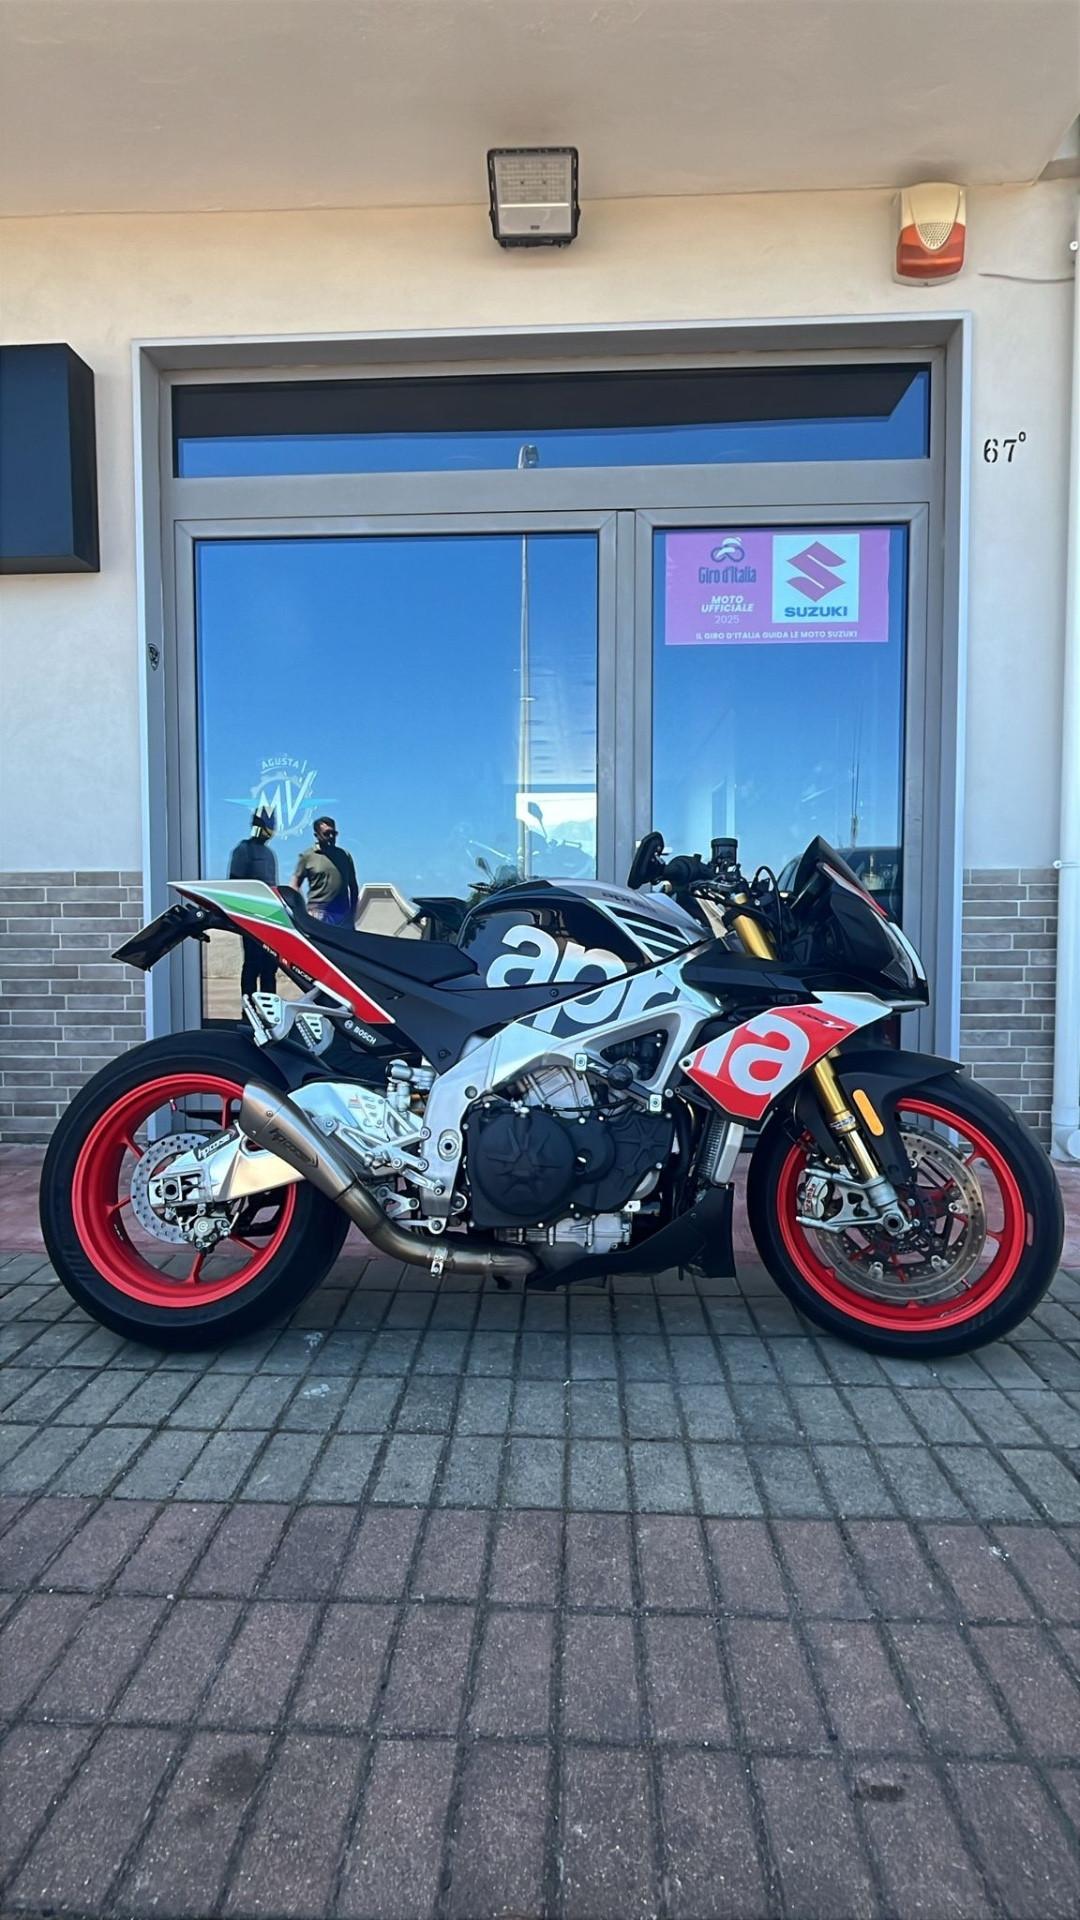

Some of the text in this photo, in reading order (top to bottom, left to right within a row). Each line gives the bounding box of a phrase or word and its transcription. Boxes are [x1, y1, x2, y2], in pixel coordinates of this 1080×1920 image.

[699, 566, 756, 584] Giro d'Italia
[711, 595, 744, 604] MOTO
[701, 603, 754, 613] UFFICIALE
[784, 606, 848, 617] SUZUKI
[714, 614, 740, 624] 2025
[704, 632, 725, 640] GIRO
[726, 631, 760, 640] D'ITALIA
[762, 631, 789, 639] GUIDA
[790, 631, 798, 639] LE
[801, 630, 826, 638] MOTO
[827, 630, 857, 638] SUZUKI
[261, 757, 299, 769] AGUSTA
[354, 1026, 377, 1045] BOSCH
